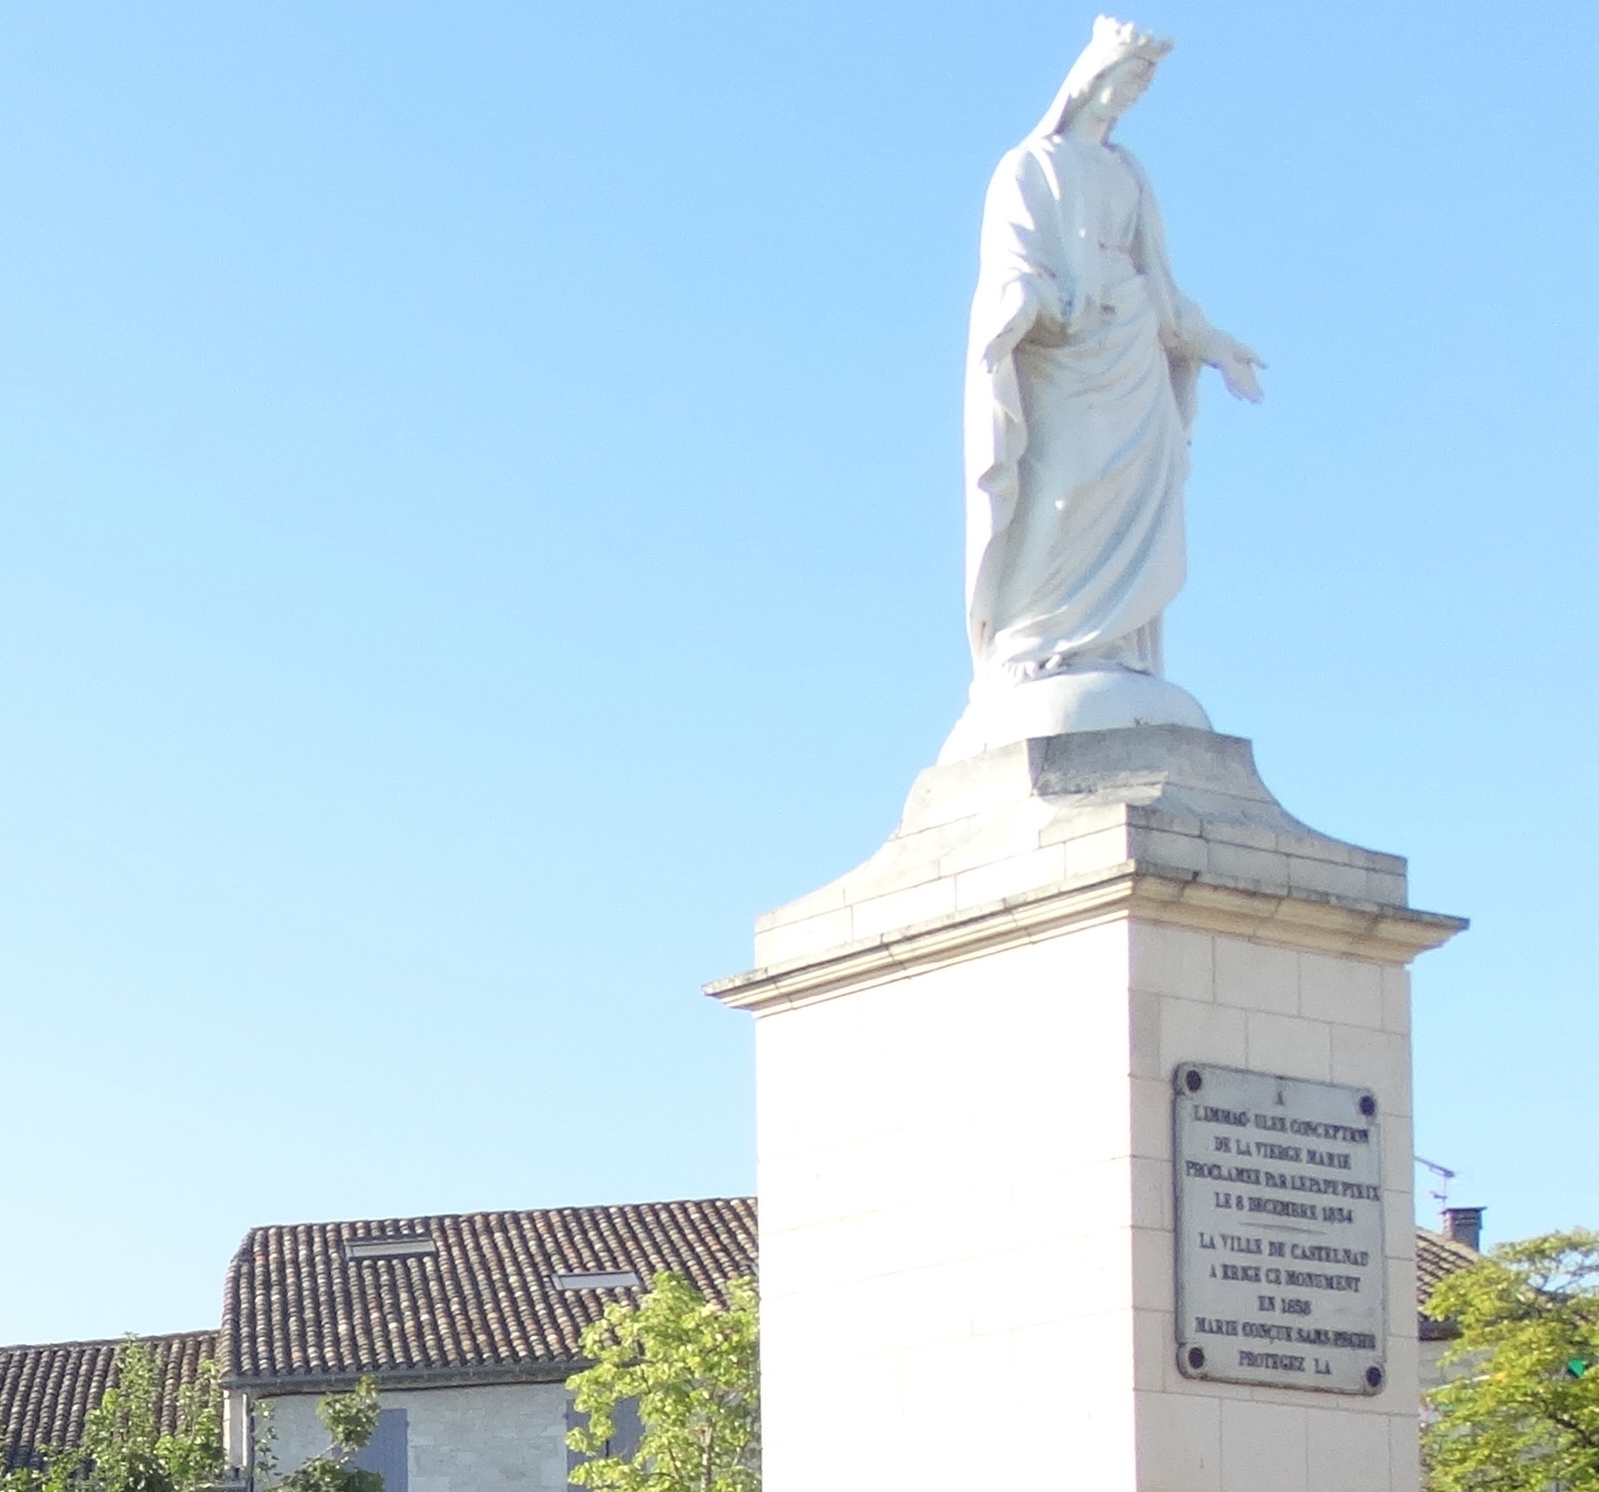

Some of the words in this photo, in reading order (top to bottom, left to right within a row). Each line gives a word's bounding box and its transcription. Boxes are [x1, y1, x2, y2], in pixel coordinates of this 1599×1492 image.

[1214, 1135, 1231, 1153] DE
[1235, 1139, 1252, 1157] LA
[1254, 1141, 1302, 1163] VIERGE
[1306, 1147, 1351, 1170] MARIE
[1265, 1171, 1287, 1189] PAR
[1214, 1192, 1232, 1209] LE
[1198, 1232, 1216, 1250] LA
[1220, 1234, 1263, 1254] VILLE
[1268, 1240, 1285, 1258] DE
[1290, 1243, 1369, 1267] CASTELNAU
[1265, 1268, 1282, 1285] CE
[1285, 1269, 1361, 1292] MONUMENT
[1257, 1295, 1276, 1312] EN
[1195, 1317, 1238, 1336] MARIE
[1313, 1357, 1332, 1375] LA
